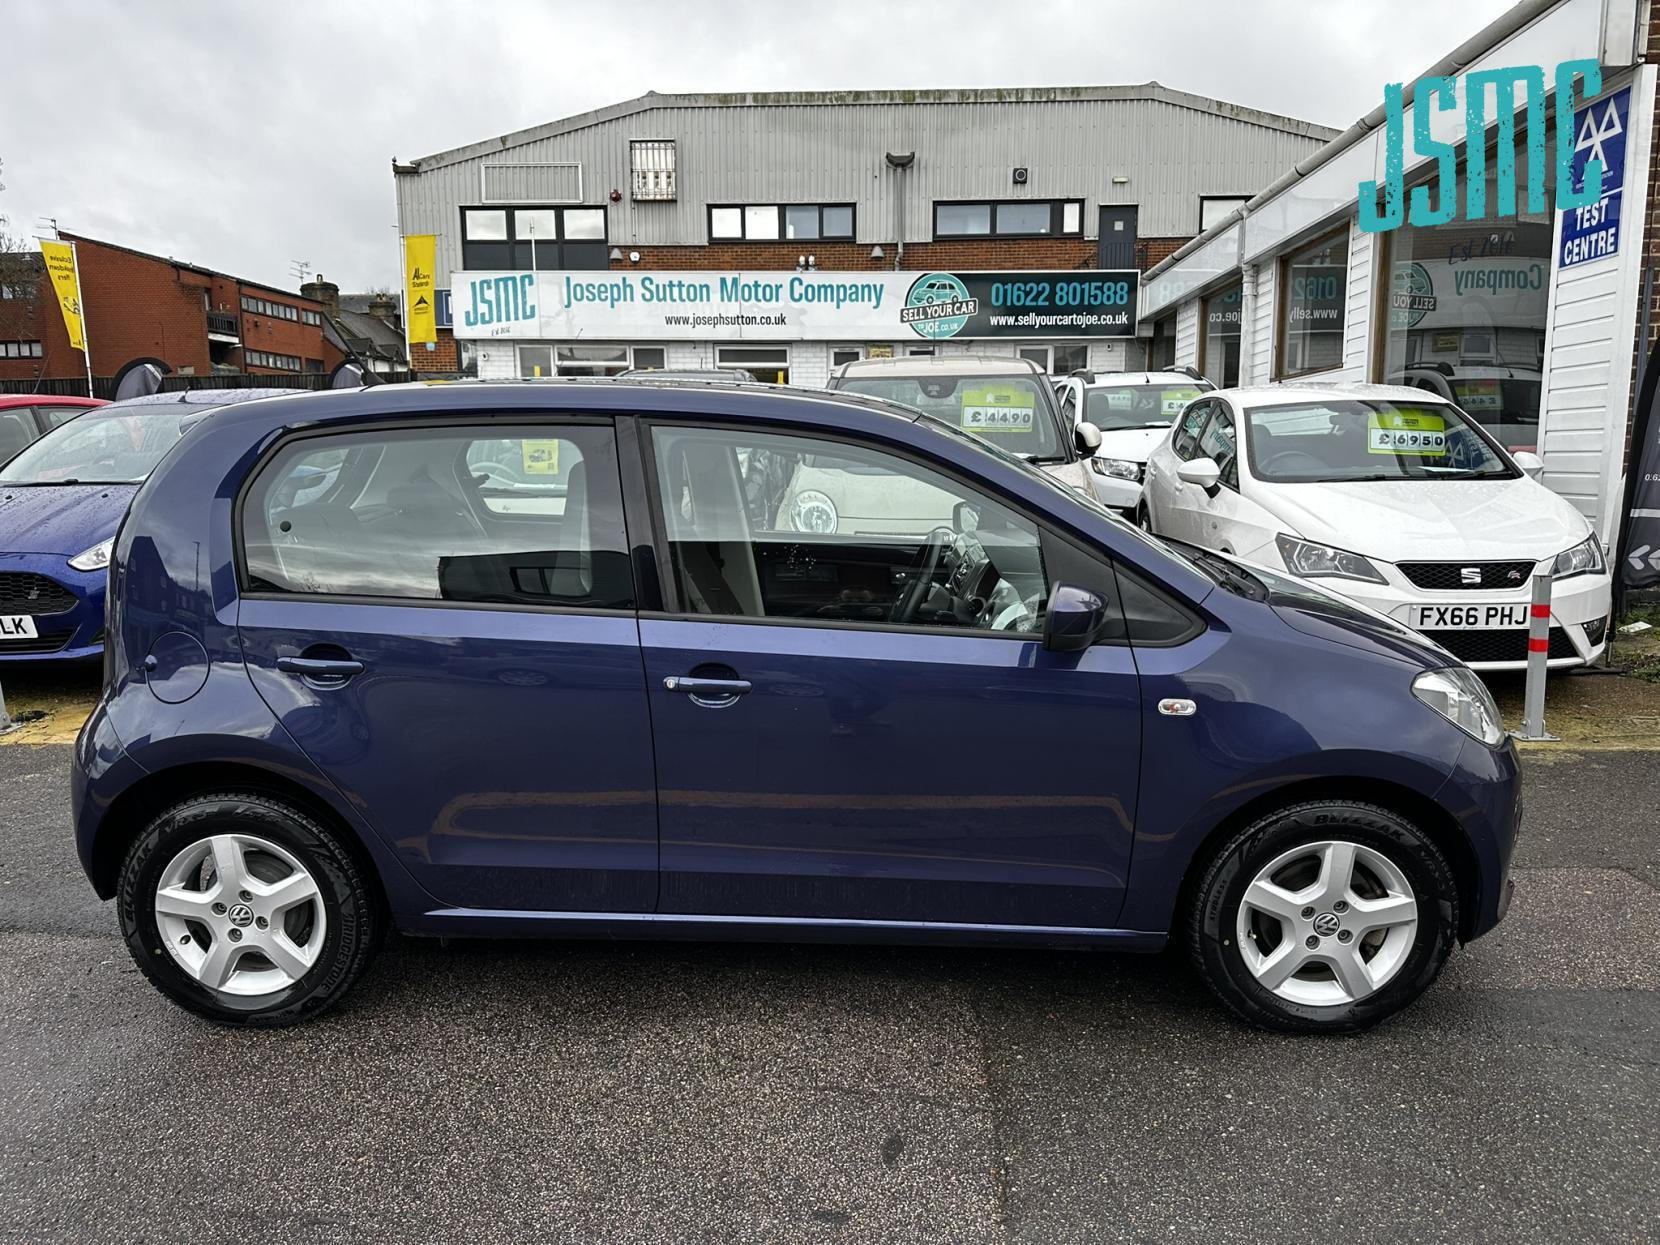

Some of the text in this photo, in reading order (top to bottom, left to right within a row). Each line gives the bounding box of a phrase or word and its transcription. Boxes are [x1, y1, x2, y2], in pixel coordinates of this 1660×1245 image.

[1575, 197, 1609, 231] TEST
[1564, 227, 1616, 265] CENTRE
[465, 274, 536, 327] JSMC
[564, 276, 884, 309] Joseph Sutton Motor Company
[991, 282, 1129, 306] 01622 801588
[665, 313, 786, 328] www.josephsutton.co.uk
[902, 301, 975, 321] SELL YOUR CAR
[990, 312, 1128, 328] www.sellyourcartojoe.co.uk
[971, 411, 1031, 423] £4490
[1379, 433, 1443, 446] £6950
[0, 617, 27, 634] LK
[1420, 606, 1528, 626] FX66 PHJ
